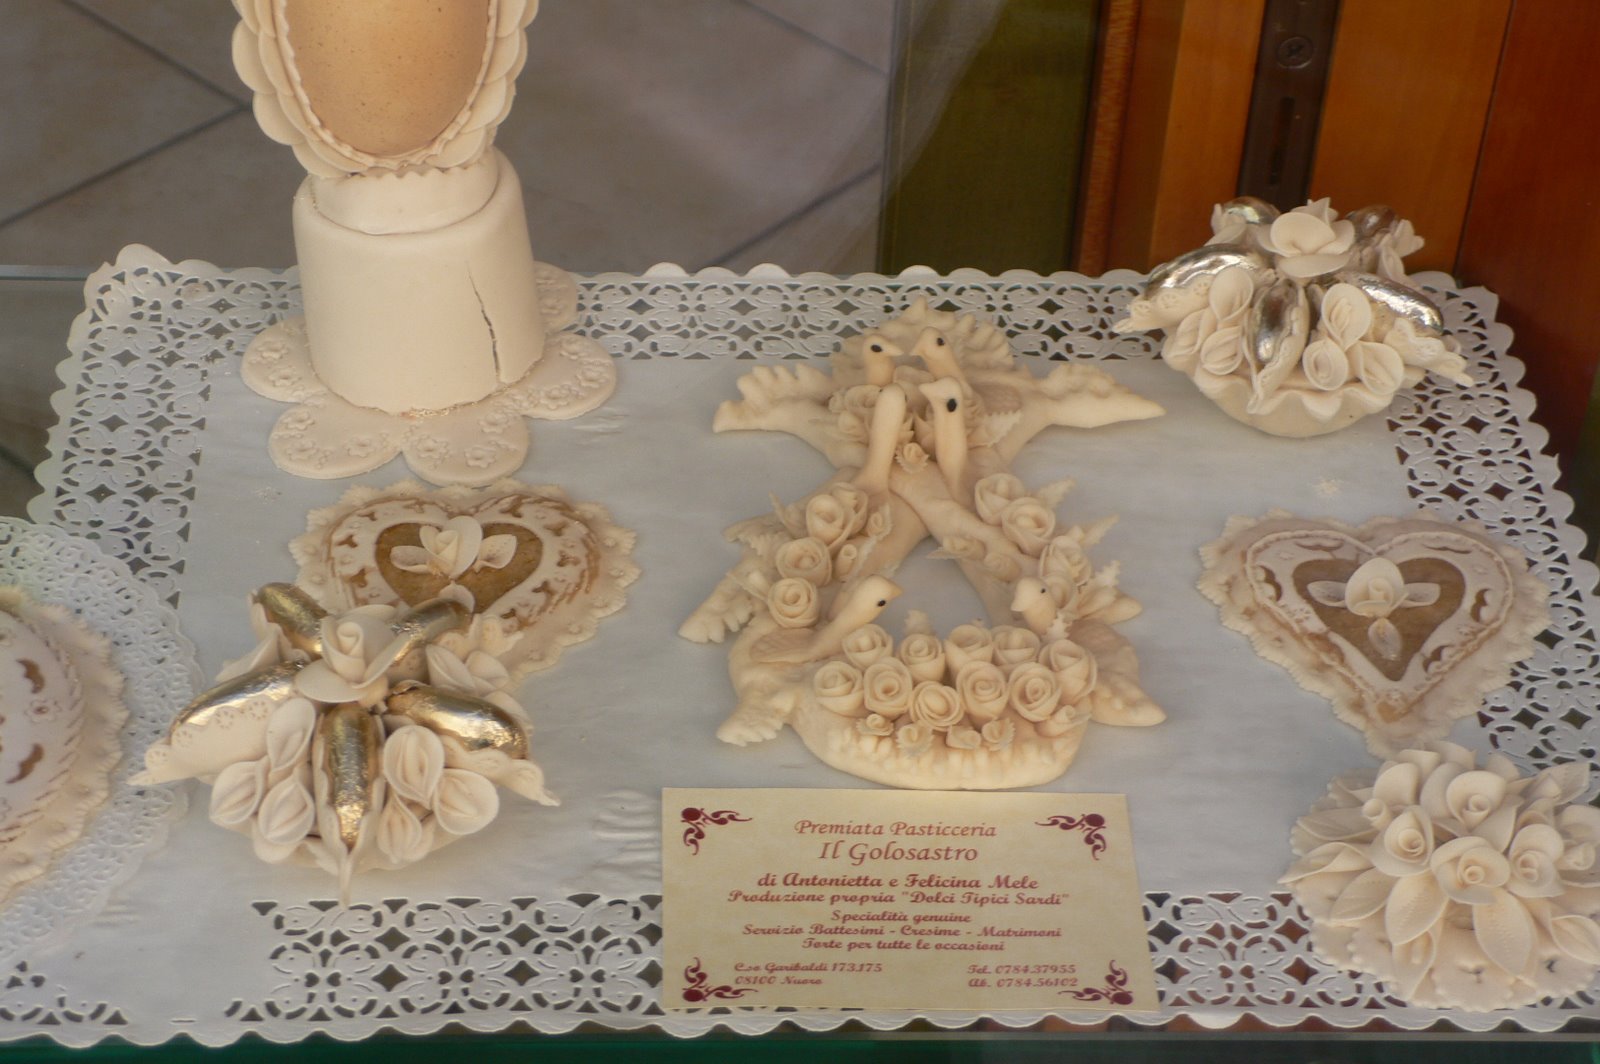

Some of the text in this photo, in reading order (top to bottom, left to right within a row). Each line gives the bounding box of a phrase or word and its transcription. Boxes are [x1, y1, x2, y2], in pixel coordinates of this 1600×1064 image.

[794, 820, 997, 836] Premiata Pasticceria
[819, 840, 978, 866] Il Golosastro
[758, 872, 1039, 889] di Antonietta e Felicina Mele
[728, 890, 1069, 907] Produzione propria "Dolci Tipici Sardi"
[831, 910, 971, 924] Specialità genuine
[742, 924, 804, 935] Servizio
[808, 923, 884, 935] Battesimi
[900, 925, 960, 936] Cresime
[978, 927, 1062, 937] Matrimoni
[802, 938, 1005, 951] Torte per tutte le occasioni
[765, 962, 828, 973] Garibaldi
[735, 976, 822, 985] 08100 Nuoro
